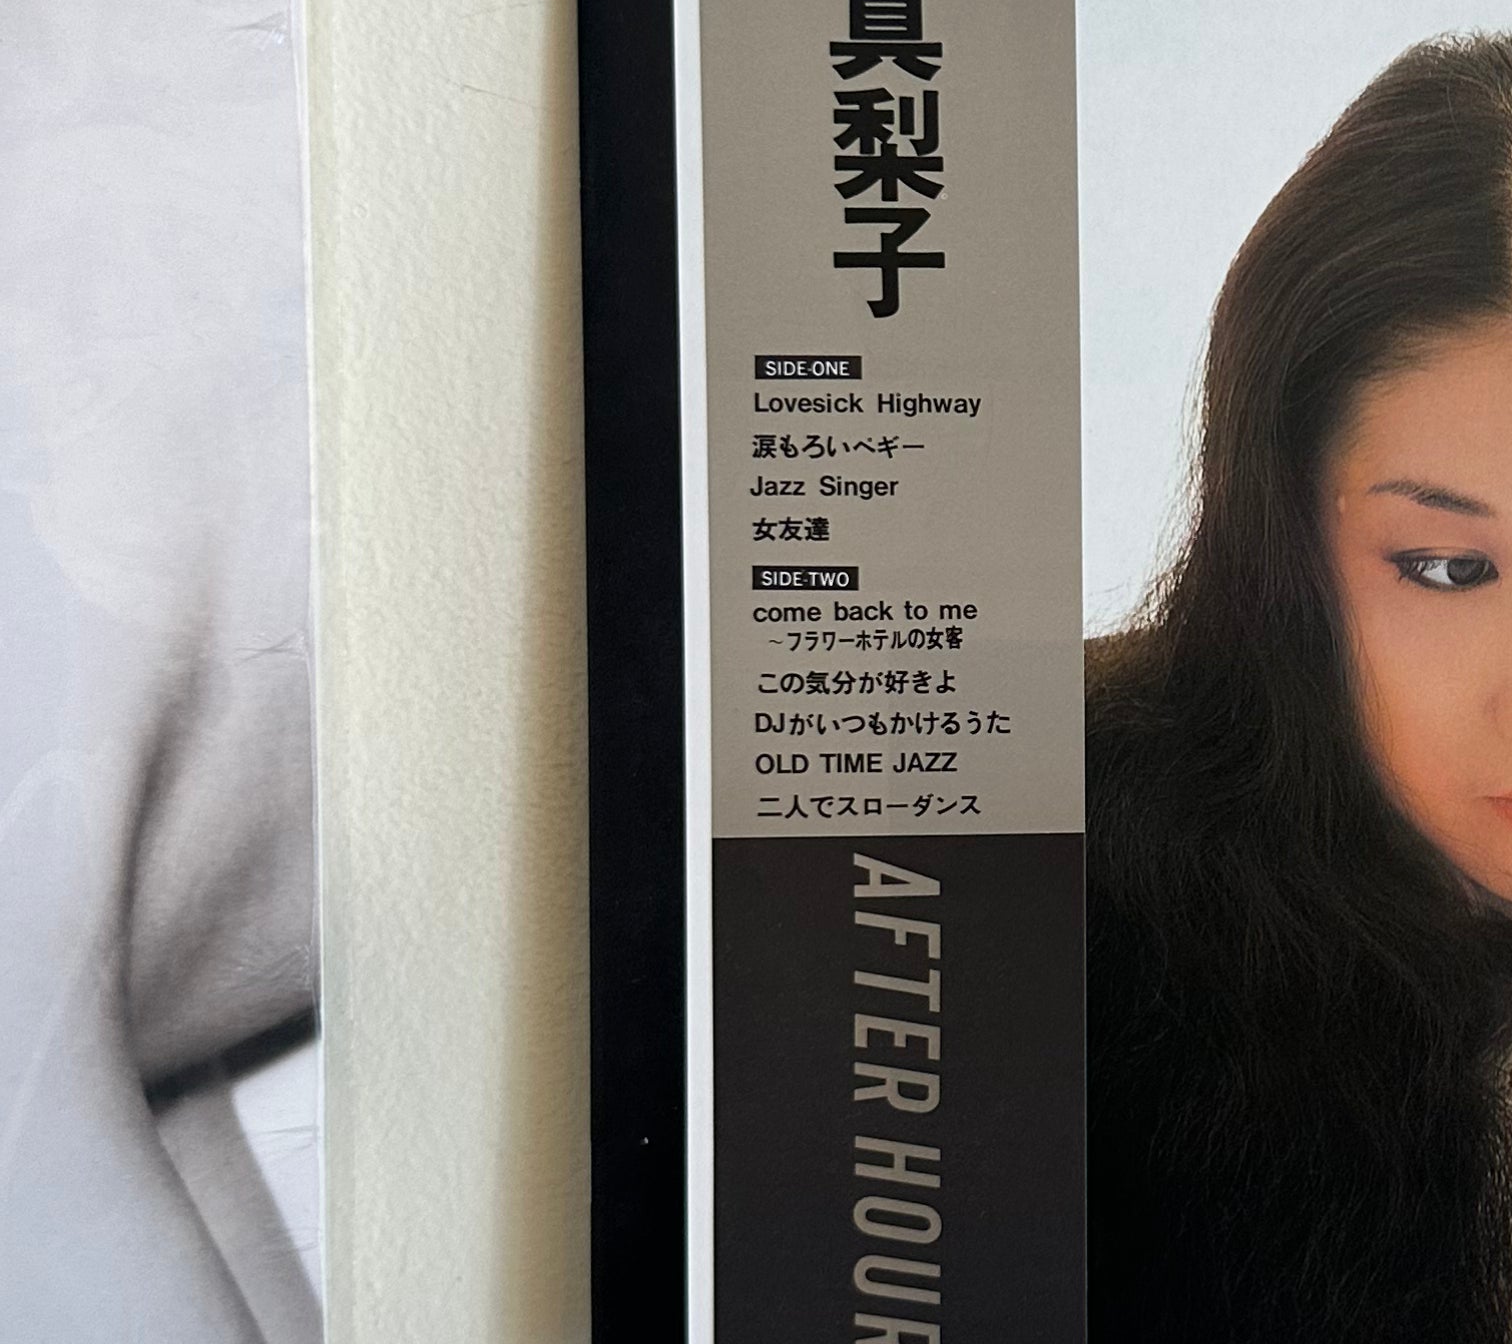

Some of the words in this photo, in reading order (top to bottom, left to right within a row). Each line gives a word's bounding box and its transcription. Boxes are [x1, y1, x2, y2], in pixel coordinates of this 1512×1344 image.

[754, 392, 864, 413] Lovesick
[877, 392, 981, 417] Highway
[750, 476, 805, 496] Jazz
[819, 475, 899, 500] Singer
[752, 517, 830, 541] 女友達
[753, 605, 822, 623] come
[834, 601, 894, 621] back
[904, 601, 928, 620] to
[939, 604, 978, 620] me
[758, 670, 957, 695] この気分が好きよ
[755, 711, 1012, 735] DJがいつもかけるうた
[755, 753, 810, 774] OLD
[819, 753, 883, 773] TIME
[893, 752, 958, 773] JAZZ
[757, 793, 981, 818] 二人でスローダンス
[853, 853, 941, 1113] AFTER
